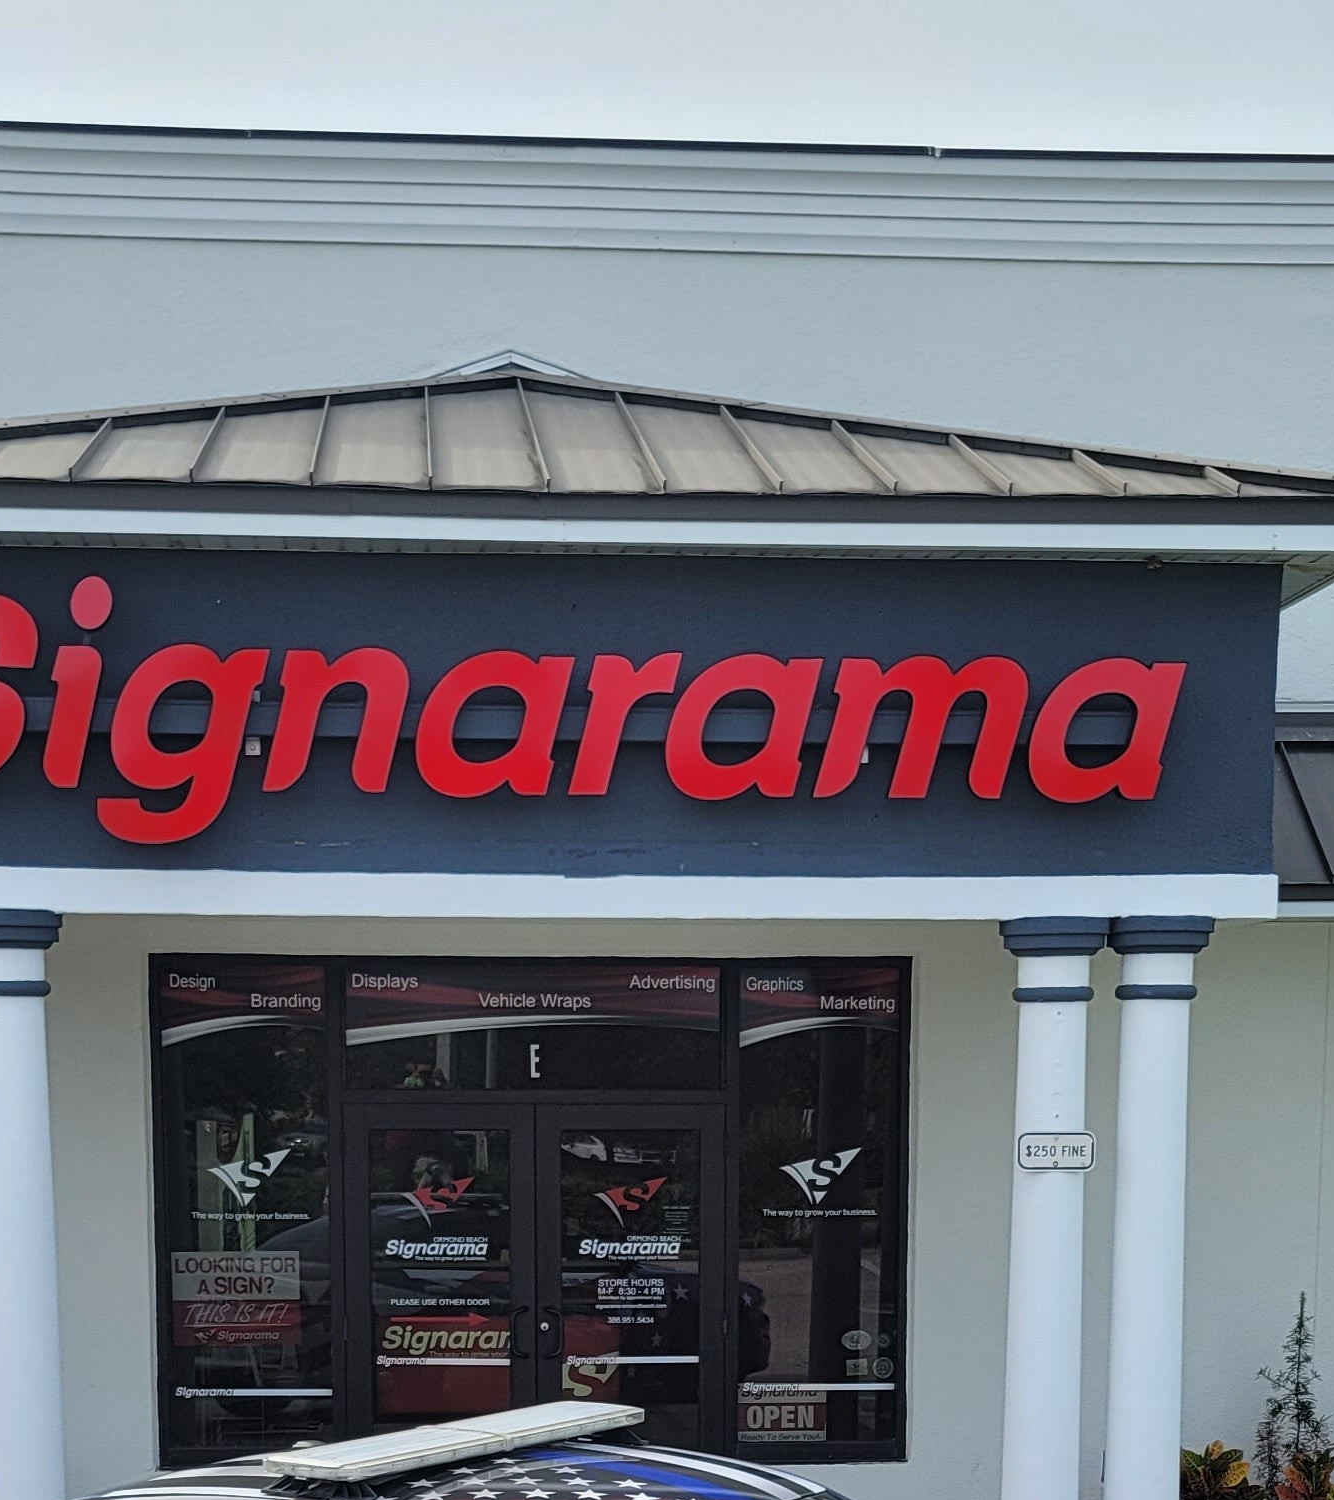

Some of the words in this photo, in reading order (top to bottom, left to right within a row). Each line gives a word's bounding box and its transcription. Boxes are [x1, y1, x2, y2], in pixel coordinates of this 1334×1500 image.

[169, 974, 216, 991] Design
[352, 974, 418, 990] Displays
[629, 974, 715, 992] Advertising
[746, 977, 804, 993] Graphics
[250, 994, 321, 1011] Branding
[479, 993, 535, 1008] Vehicle
[540, 994, 591, 1011] Wraps
[820, 996, 895, 1013] Marketing
[529, 1044, 541, 1078] E
[1025, 1145, 1057, 1157] $250
[1061, 1145, 1086, 1157] FINE
[191, 1211, 206, 1219] The
[208, 1213, 224, 1221] way
[235, 1213, 255, 1221] grow
[256, 1213, 274, 1221] your
[778, 1210, 793, 1218] way
[805, 1210, 824, 1218] grow
[385, 1239, 488, 1259] Signarama
[579, 1239, 681, 1258] Signarama
[175, 1257, 255, 1273] LOOKING
[261, 1257, 296, 1273] FOR
[197, 1279, 210, 1294] A
[214, 1277, 274, 1295] SIGN?
[597, 1278, 629, 1287] STORE
[631, 1278, 664, 1287] HOURS
[597, 1287, 614, 1295] M-F
[618, 1287, 636, 1295] 8:30
[643, 1287, 649, 1295] 4
[651, 1287, 665, 1295] PM
[390, 1298, 420, 1306] PLEASE
[421, 1298, 437, 1306] USE
[438, 1298, 465, 1306] OTHER
[467, 1298, 490, 1306] DOOR
[184, 1303, 231, 1324] THIS
[234, 1303, 255, 1323] IS
[259, 1303, 289, 1323] IT!
[217, 1330, 280, 1342] Signarama
[376, 1355, 426, 1367] Signarama
[567, 1355, 615, 1367] Signarama
[175, 1386, 233, 1398] Signarama
[742, 1382, 798, 1394] Signarama
[747, 1405, 814, 1429] OPEN
[741, 1433, 765, 1441] Ready
